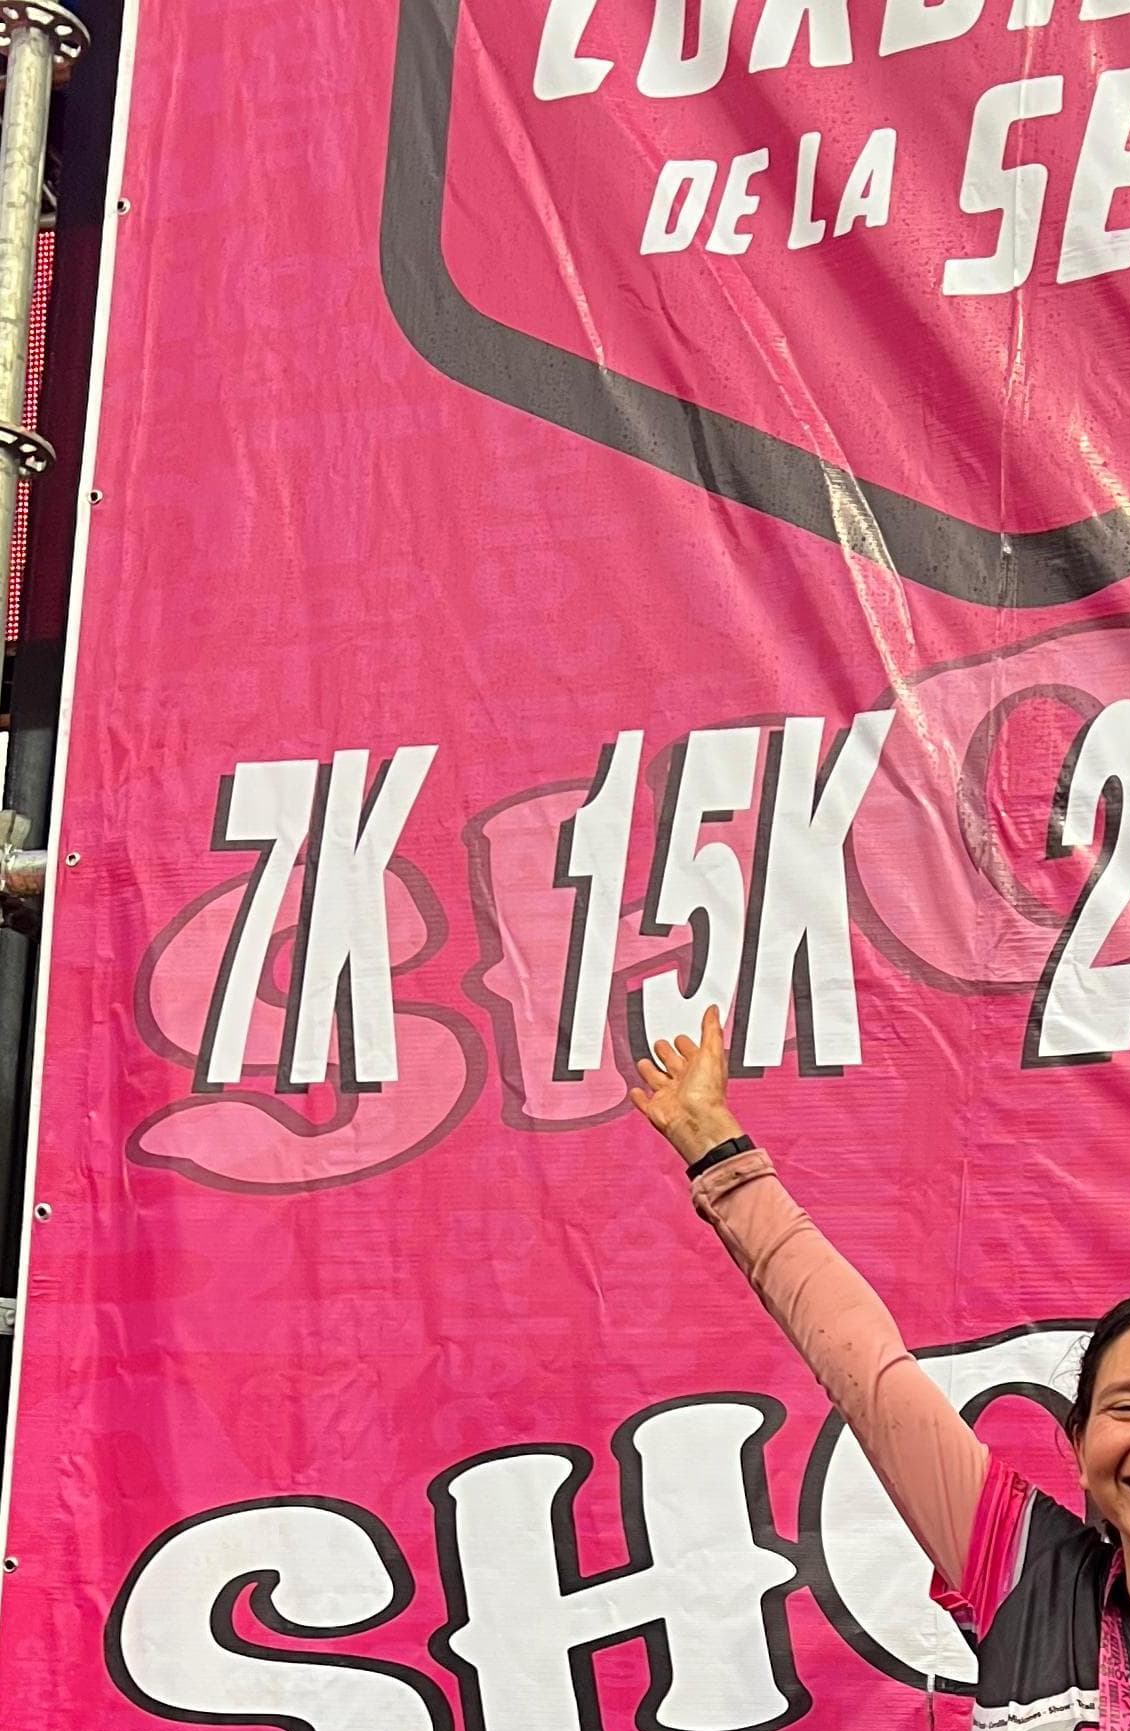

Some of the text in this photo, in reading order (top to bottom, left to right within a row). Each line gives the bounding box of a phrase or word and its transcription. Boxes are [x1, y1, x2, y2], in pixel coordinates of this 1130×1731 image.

[640, 148, 769, 255] DE
[787, 128, 896, 250] LA
[191, 745, 439, 1093] 7K
[551, 709, 896, 1083] 15K
